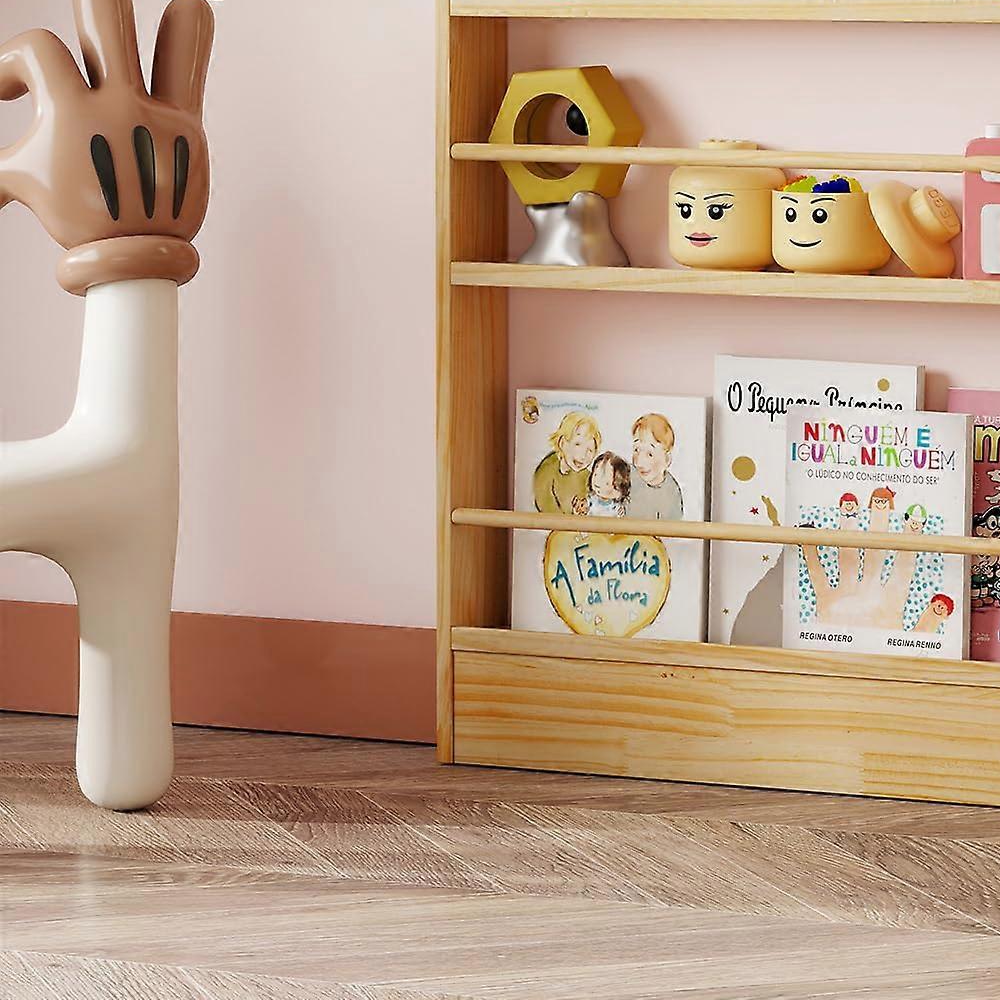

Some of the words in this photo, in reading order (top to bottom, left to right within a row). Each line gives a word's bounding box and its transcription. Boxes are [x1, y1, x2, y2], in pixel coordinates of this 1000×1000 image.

[728, 382, 742, 412] O
[791, 443, 848, 465] IGUAL
[856, 471, 911, 484] CONHECIMENTO
[913, 475, 924, 485] DO
[551, 560, 576, 607] A
[574, 540, 660, 581] Família
[587, 588, 602, 605] da
[606, 578, 649, 606] Flora
[799, 631, 827, 642] REGINA
[827, 633, 853, 643] OTERO
[887, 638, 915, 648] REGINA
